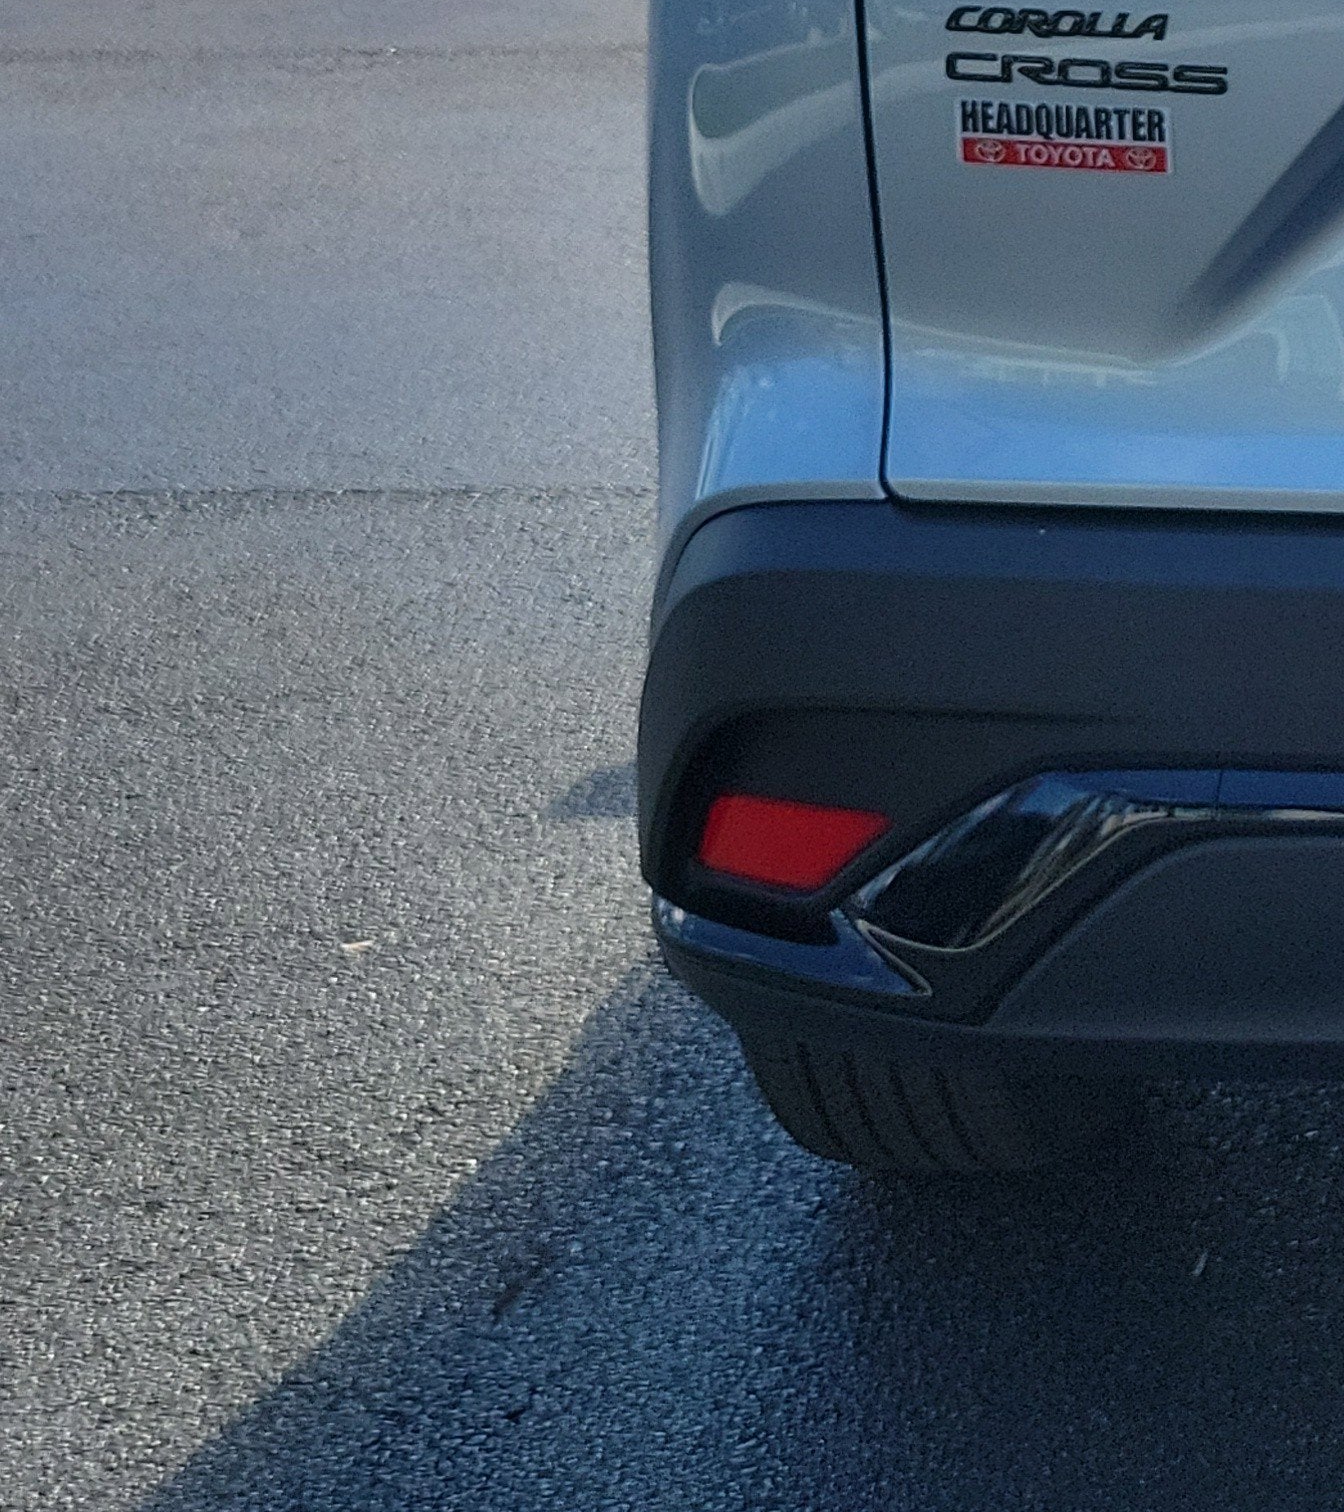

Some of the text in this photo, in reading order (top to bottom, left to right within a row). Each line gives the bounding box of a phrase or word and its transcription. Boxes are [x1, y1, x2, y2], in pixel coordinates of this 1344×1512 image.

[945, 6, 1169, 40] COROLLA
[946, 52, 1228, 95] CROSS
[961, 100, 1166, 142] HEADQUARTER
[1015, 142, 1116, 169] TOYOTA
